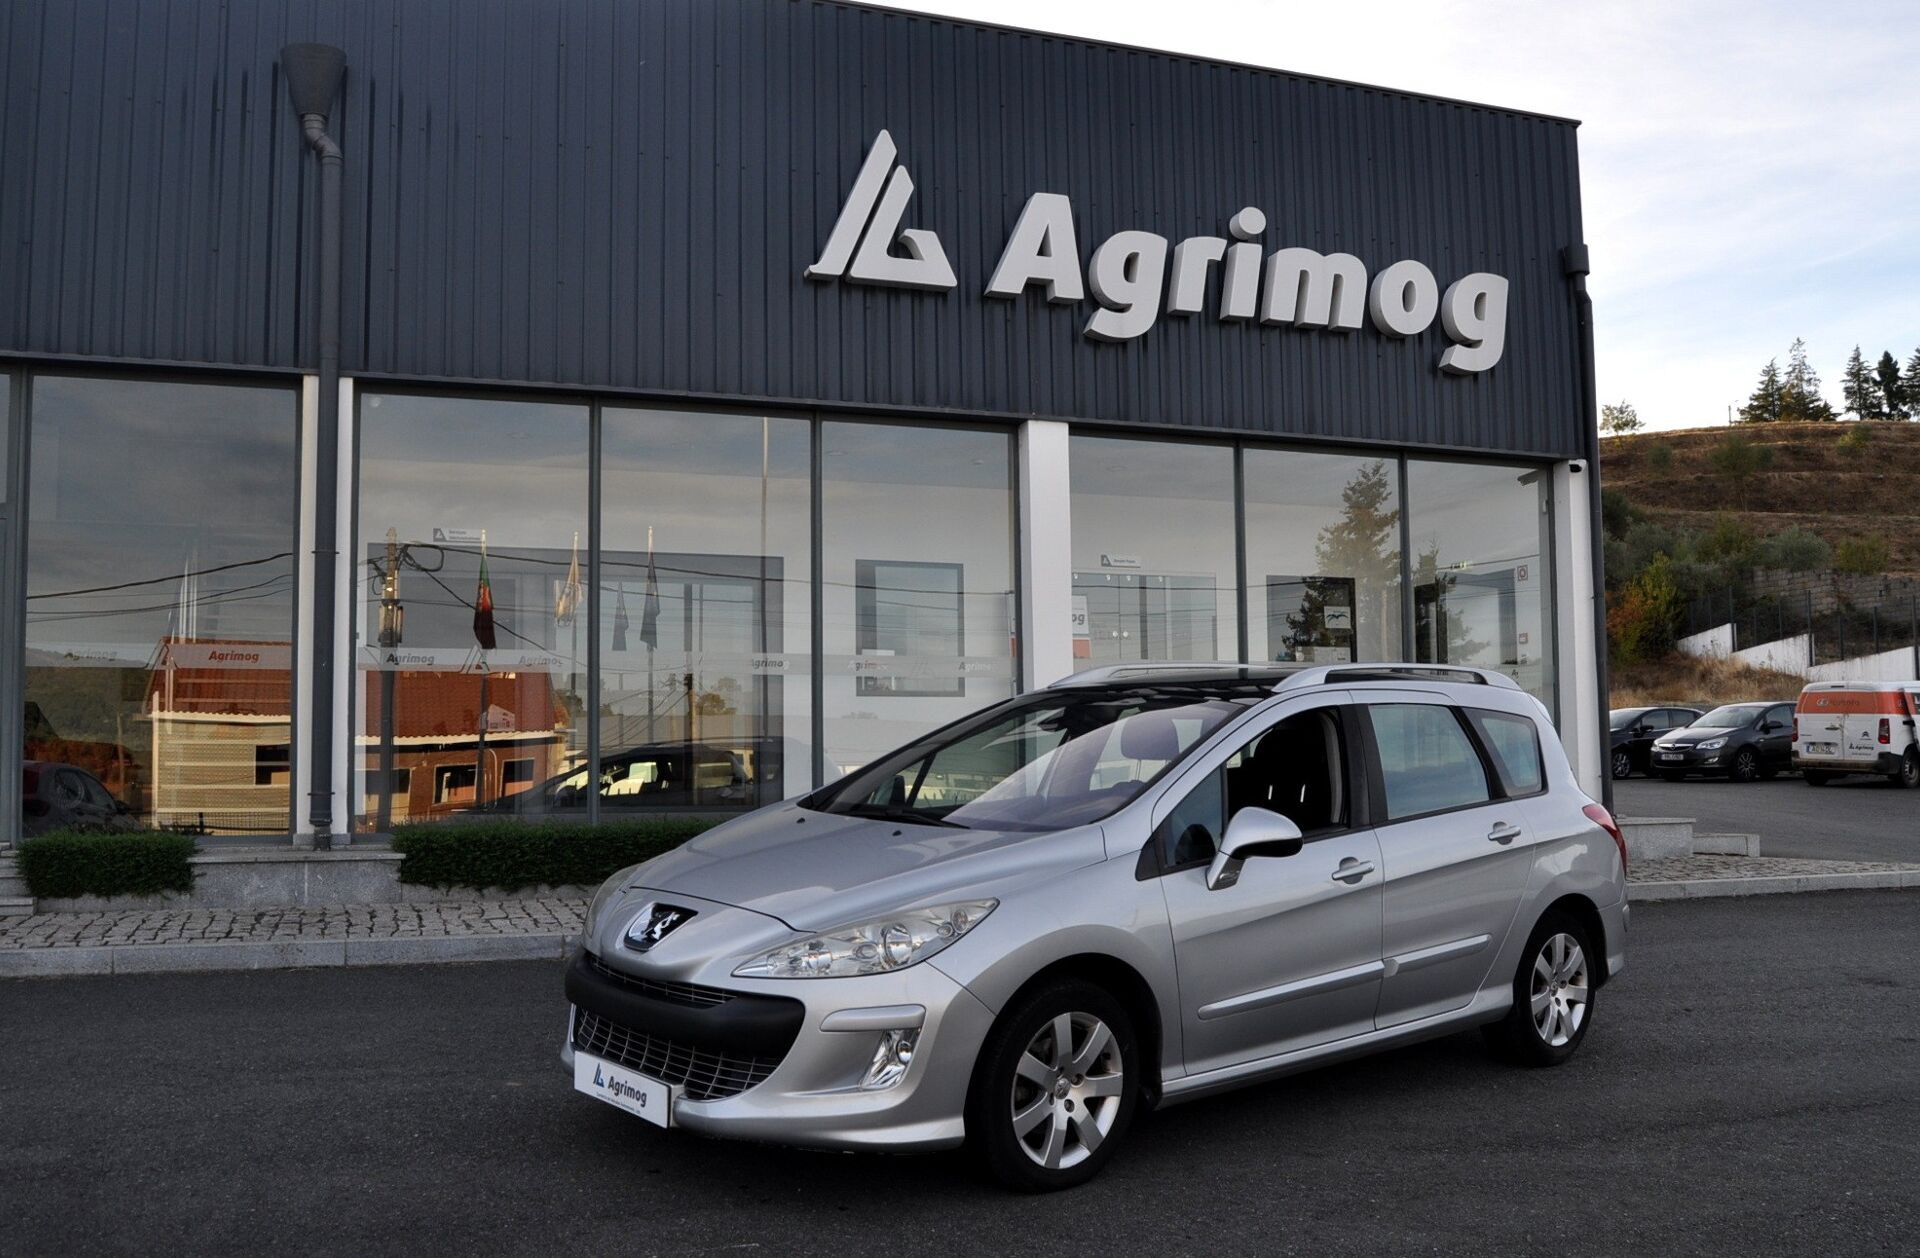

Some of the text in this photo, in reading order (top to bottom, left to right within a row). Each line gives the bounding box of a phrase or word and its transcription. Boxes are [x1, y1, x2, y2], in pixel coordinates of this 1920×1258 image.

[984, 192, 1509, 374] Agrimog
[208, 651, 260, 662] Agrimog
[386, 653, 435, 665] Agrimog
[608, 1076, 647, 1108] Agrimog
